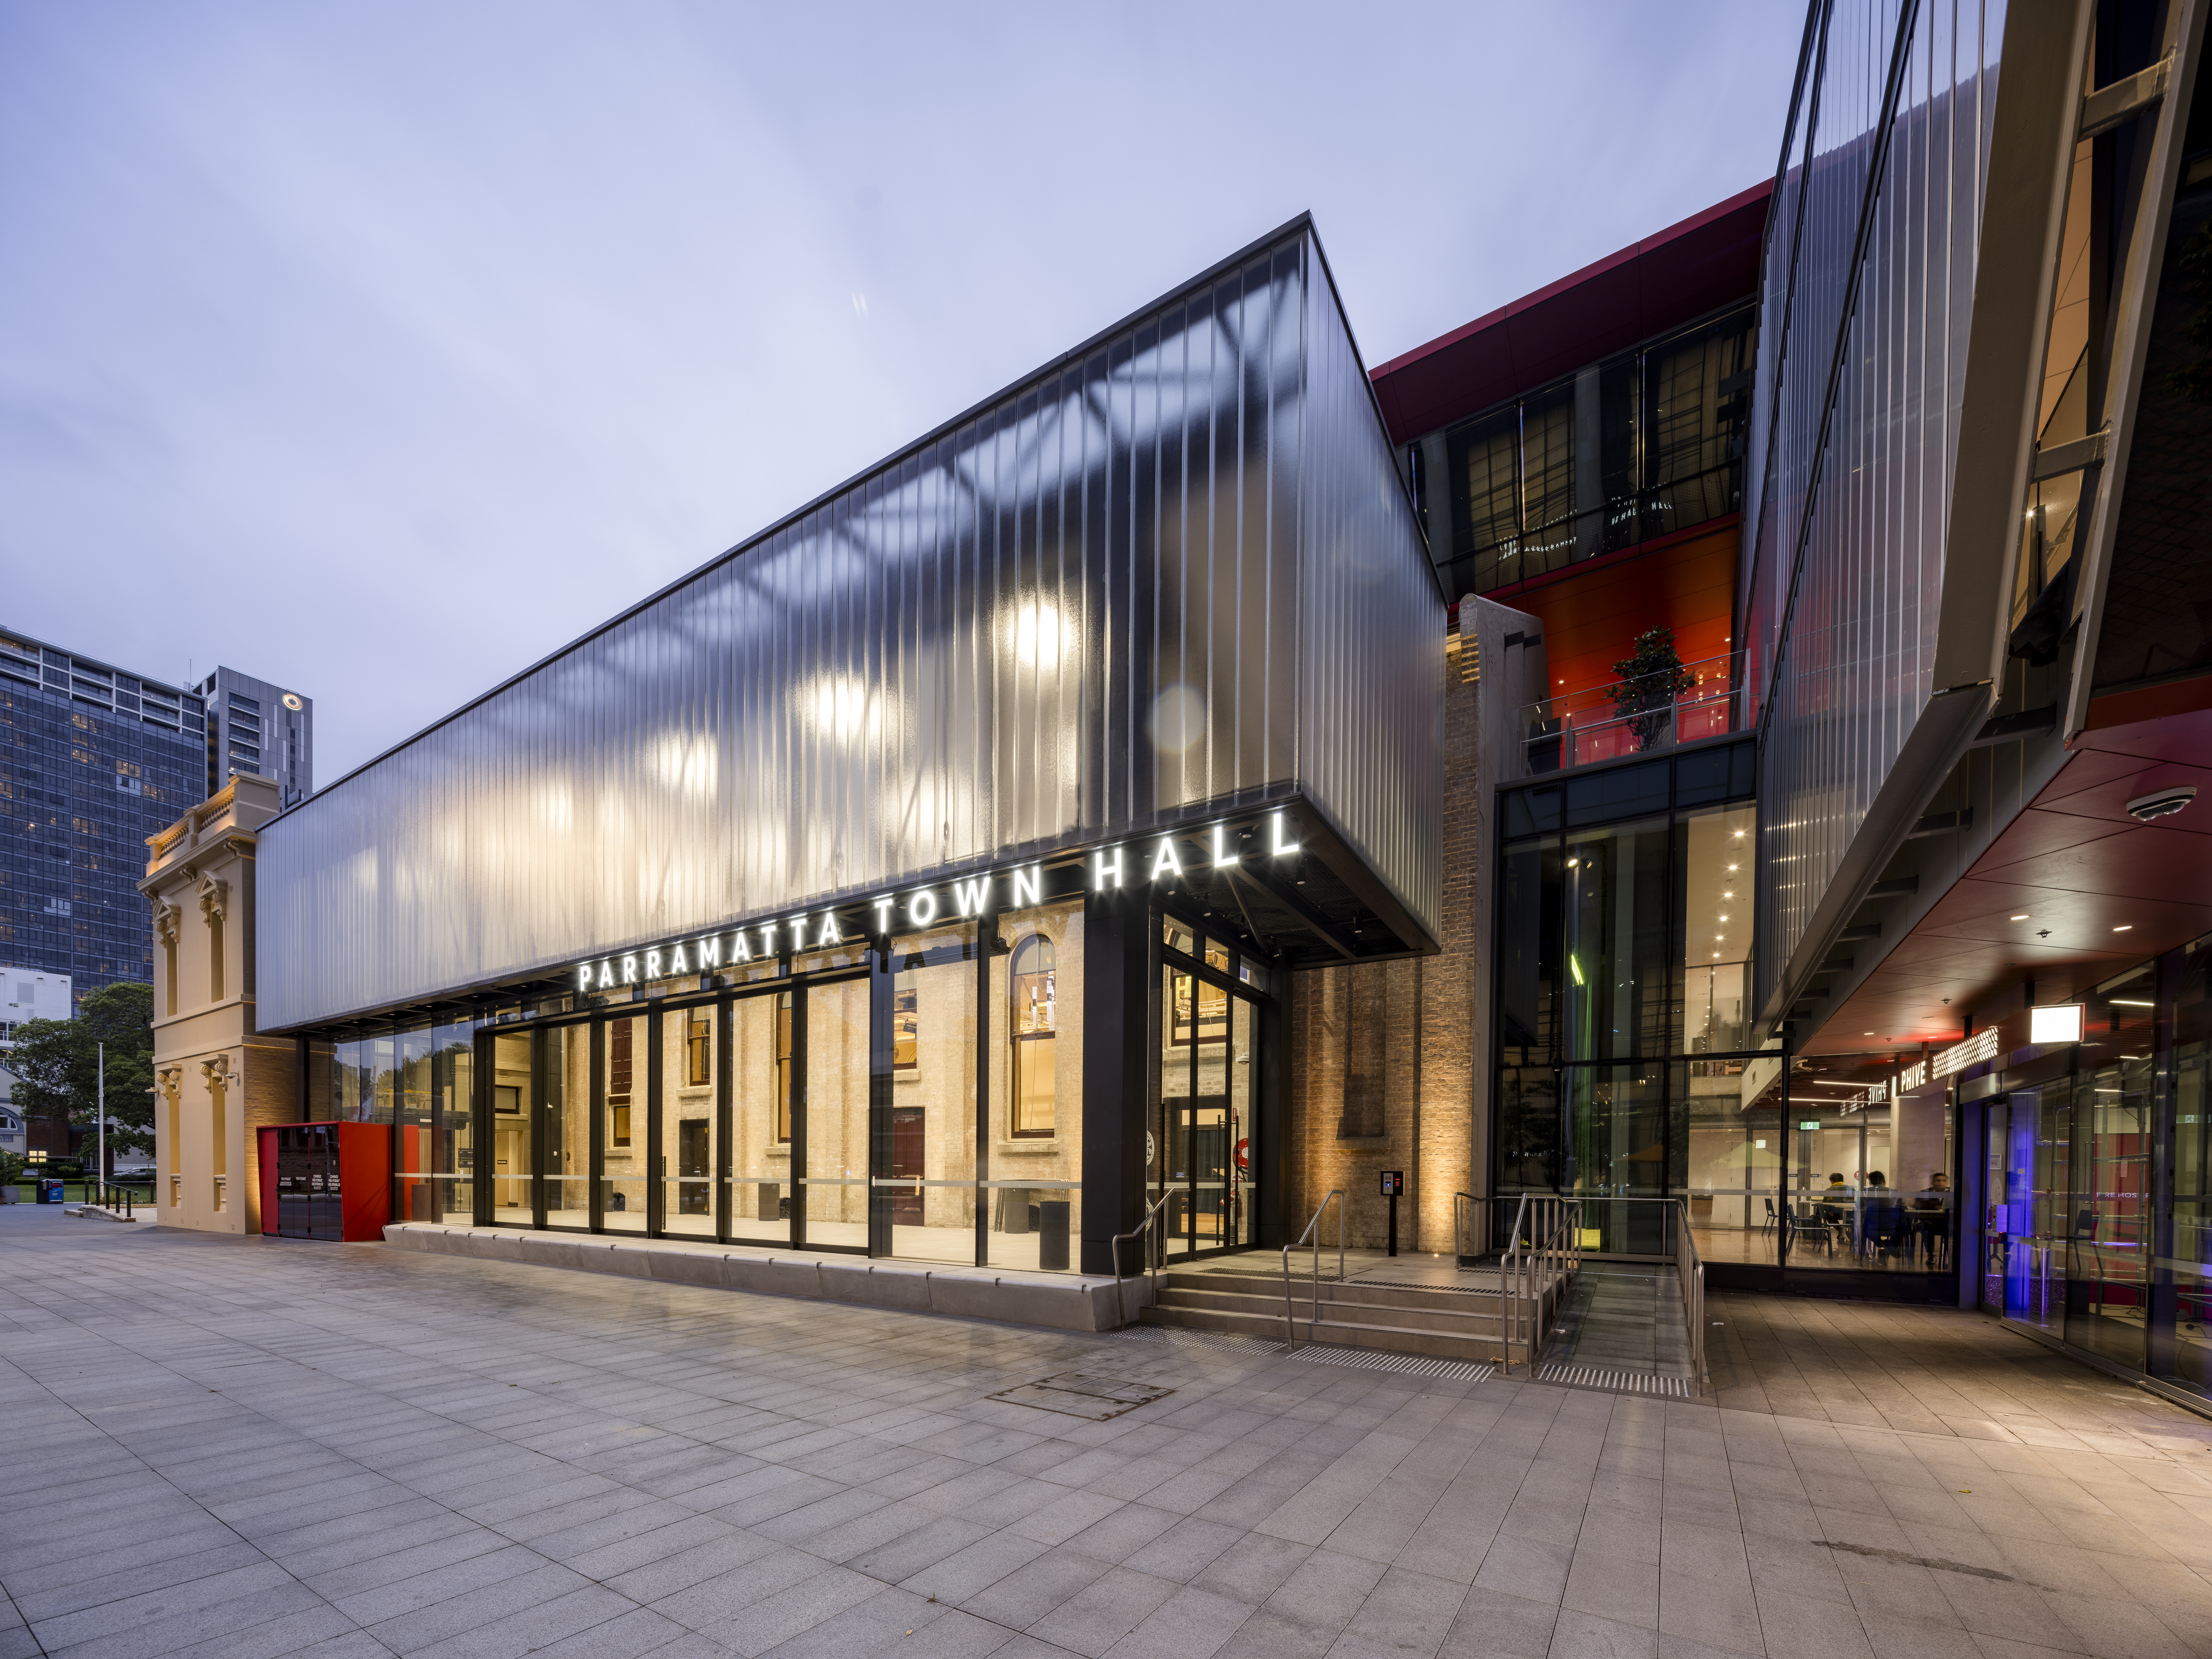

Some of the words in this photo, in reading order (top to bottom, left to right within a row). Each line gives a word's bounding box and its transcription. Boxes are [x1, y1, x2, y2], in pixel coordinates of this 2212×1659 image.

[580, 912, 840, 990] PARRAMATTA
[875, 866, 1039, 932] TOWN
[1095, 813, 1299, 890] HALL
[1901, 1061, 1926, 1092] PHIVE
